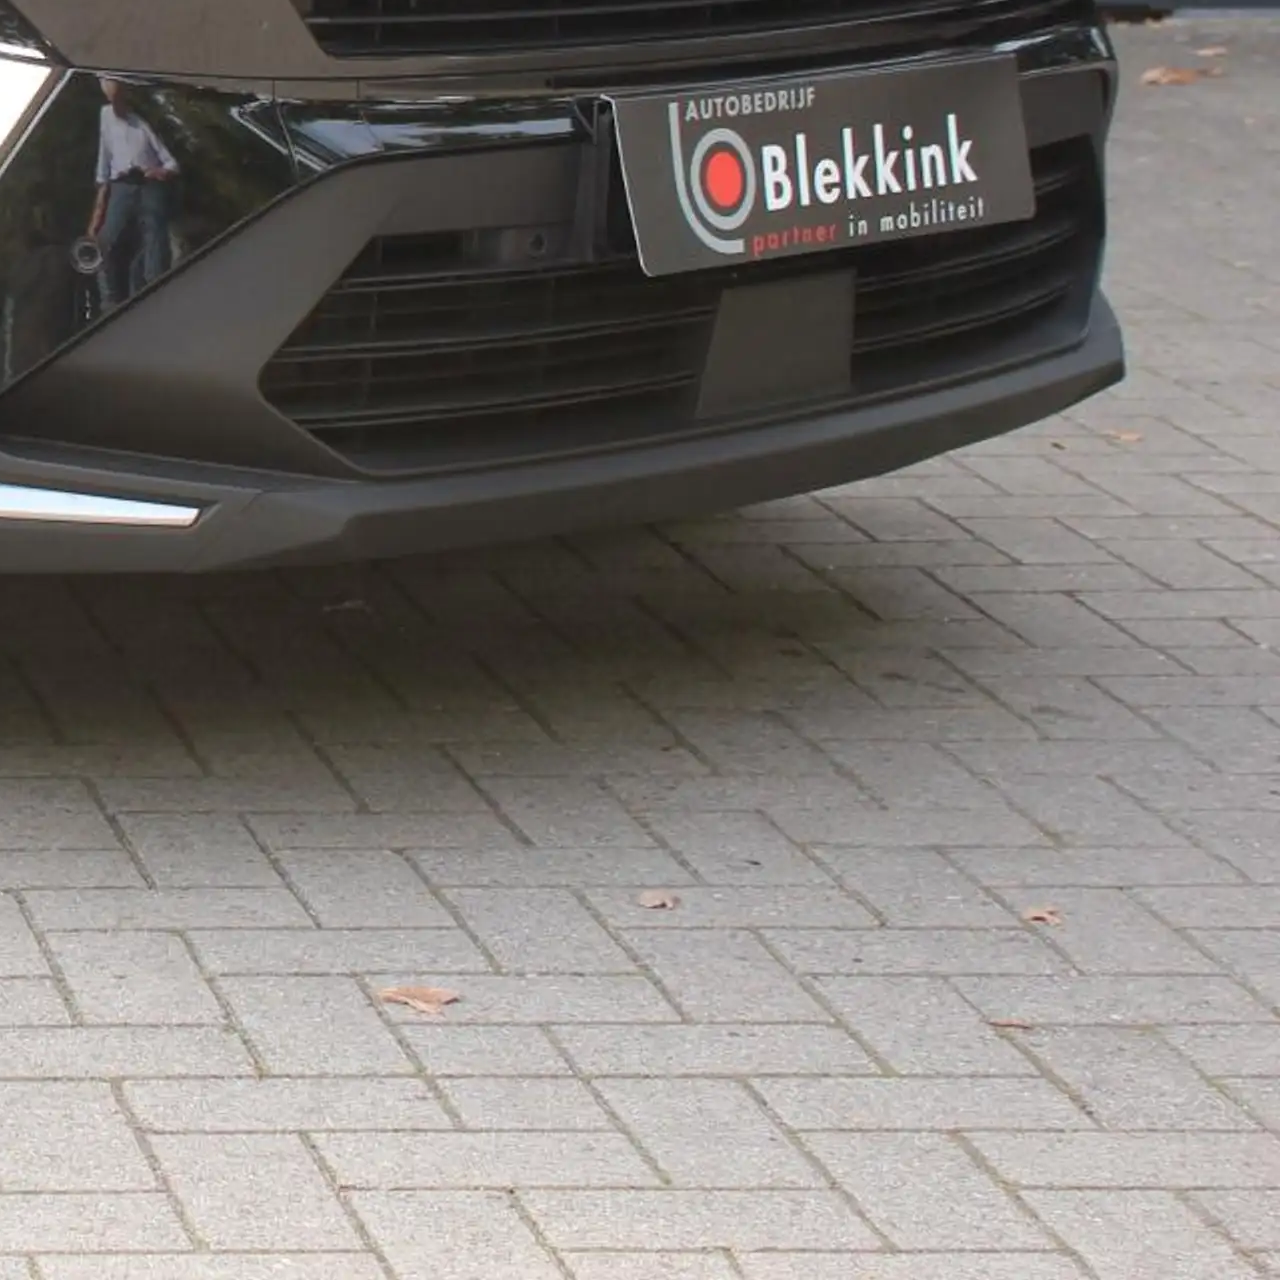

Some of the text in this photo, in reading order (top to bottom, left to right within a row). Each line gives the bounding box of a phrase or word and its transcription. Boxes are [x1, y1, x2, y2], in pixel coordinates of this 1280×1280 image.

[685, 86, 816, 122] AUTOBEDRIJF
[761, 113, 978, 212] Blekkink
[753, 196, 984, 258] partner in mobiliteit
